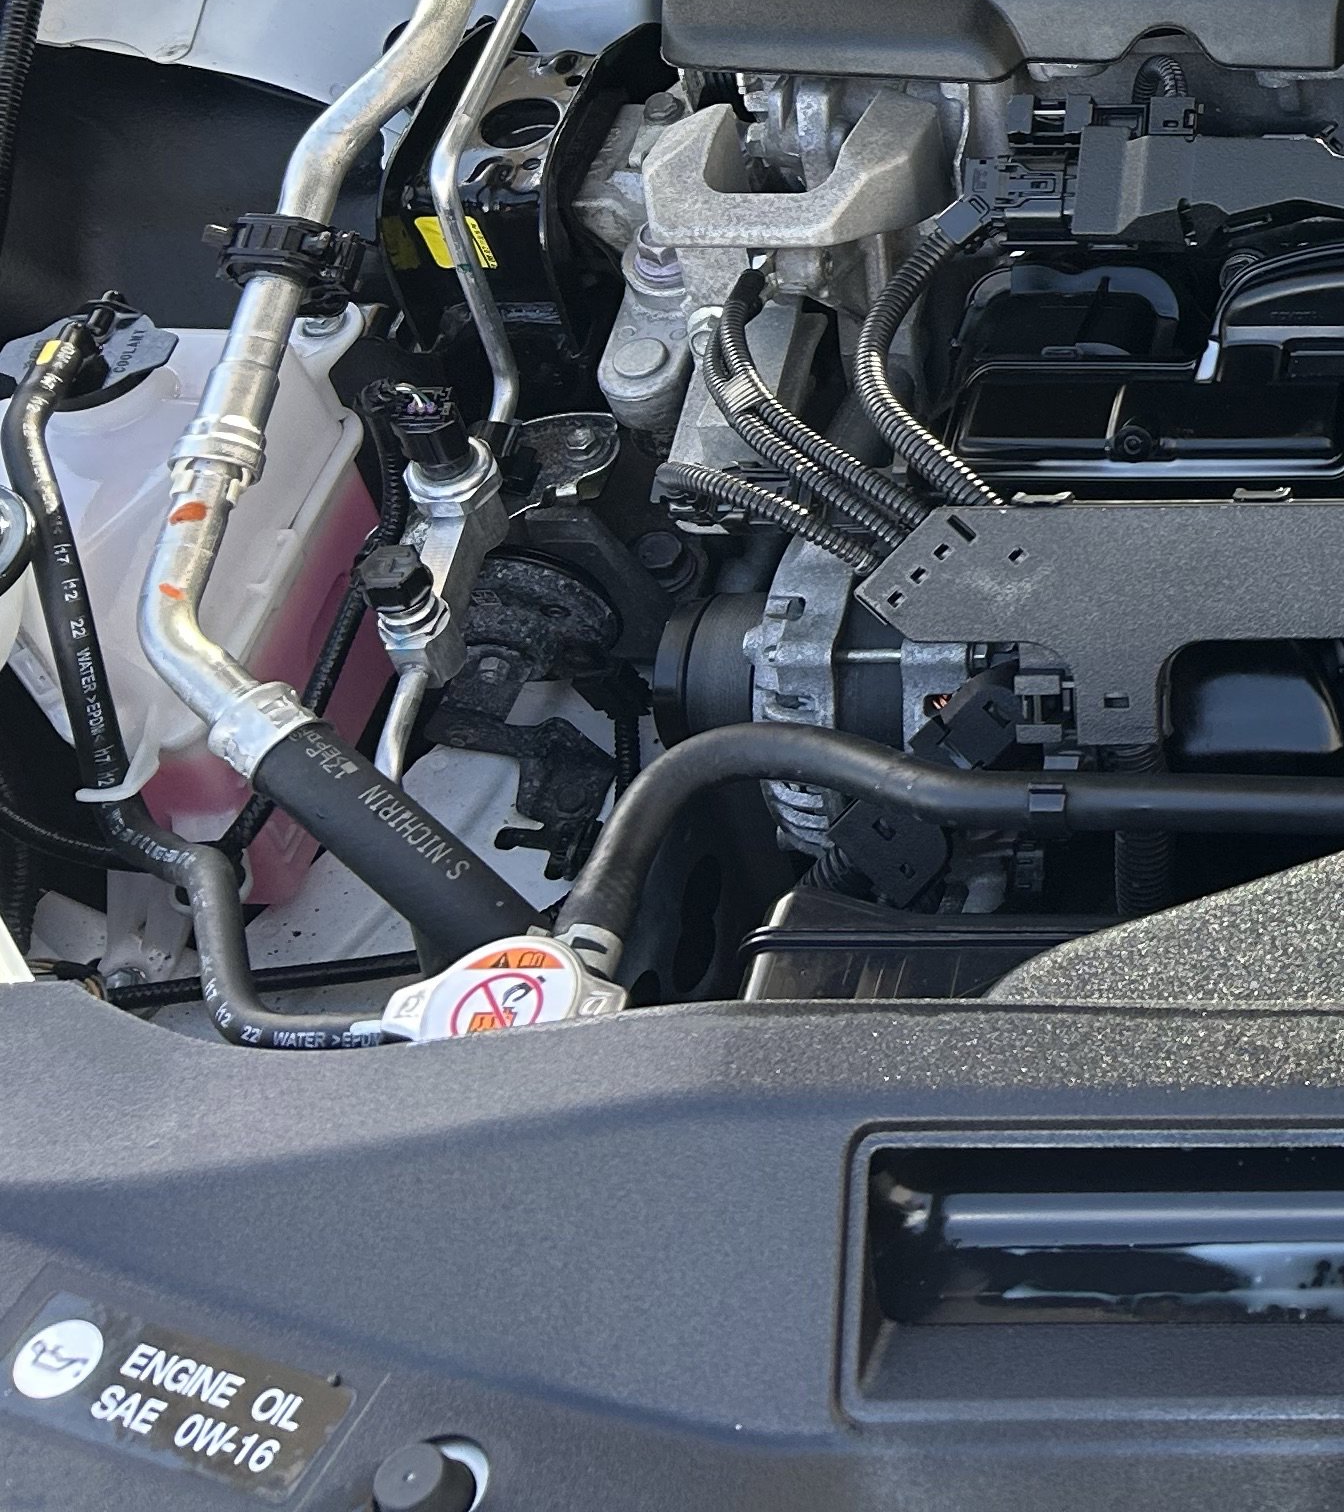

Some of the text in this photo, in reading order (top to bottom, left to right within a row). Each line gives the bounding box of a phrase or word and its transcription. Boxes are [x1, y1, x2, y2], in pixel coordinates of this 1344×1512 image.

[113, 330, 145, 373] COOLANT
[76, 647, 97, 694] WATER
[273, 1031, 327, 1048] WATER
[119, 1343, 304, 1432] ENGINE OIL
[91, 1384, 281, 1473] SAE 0W-16
